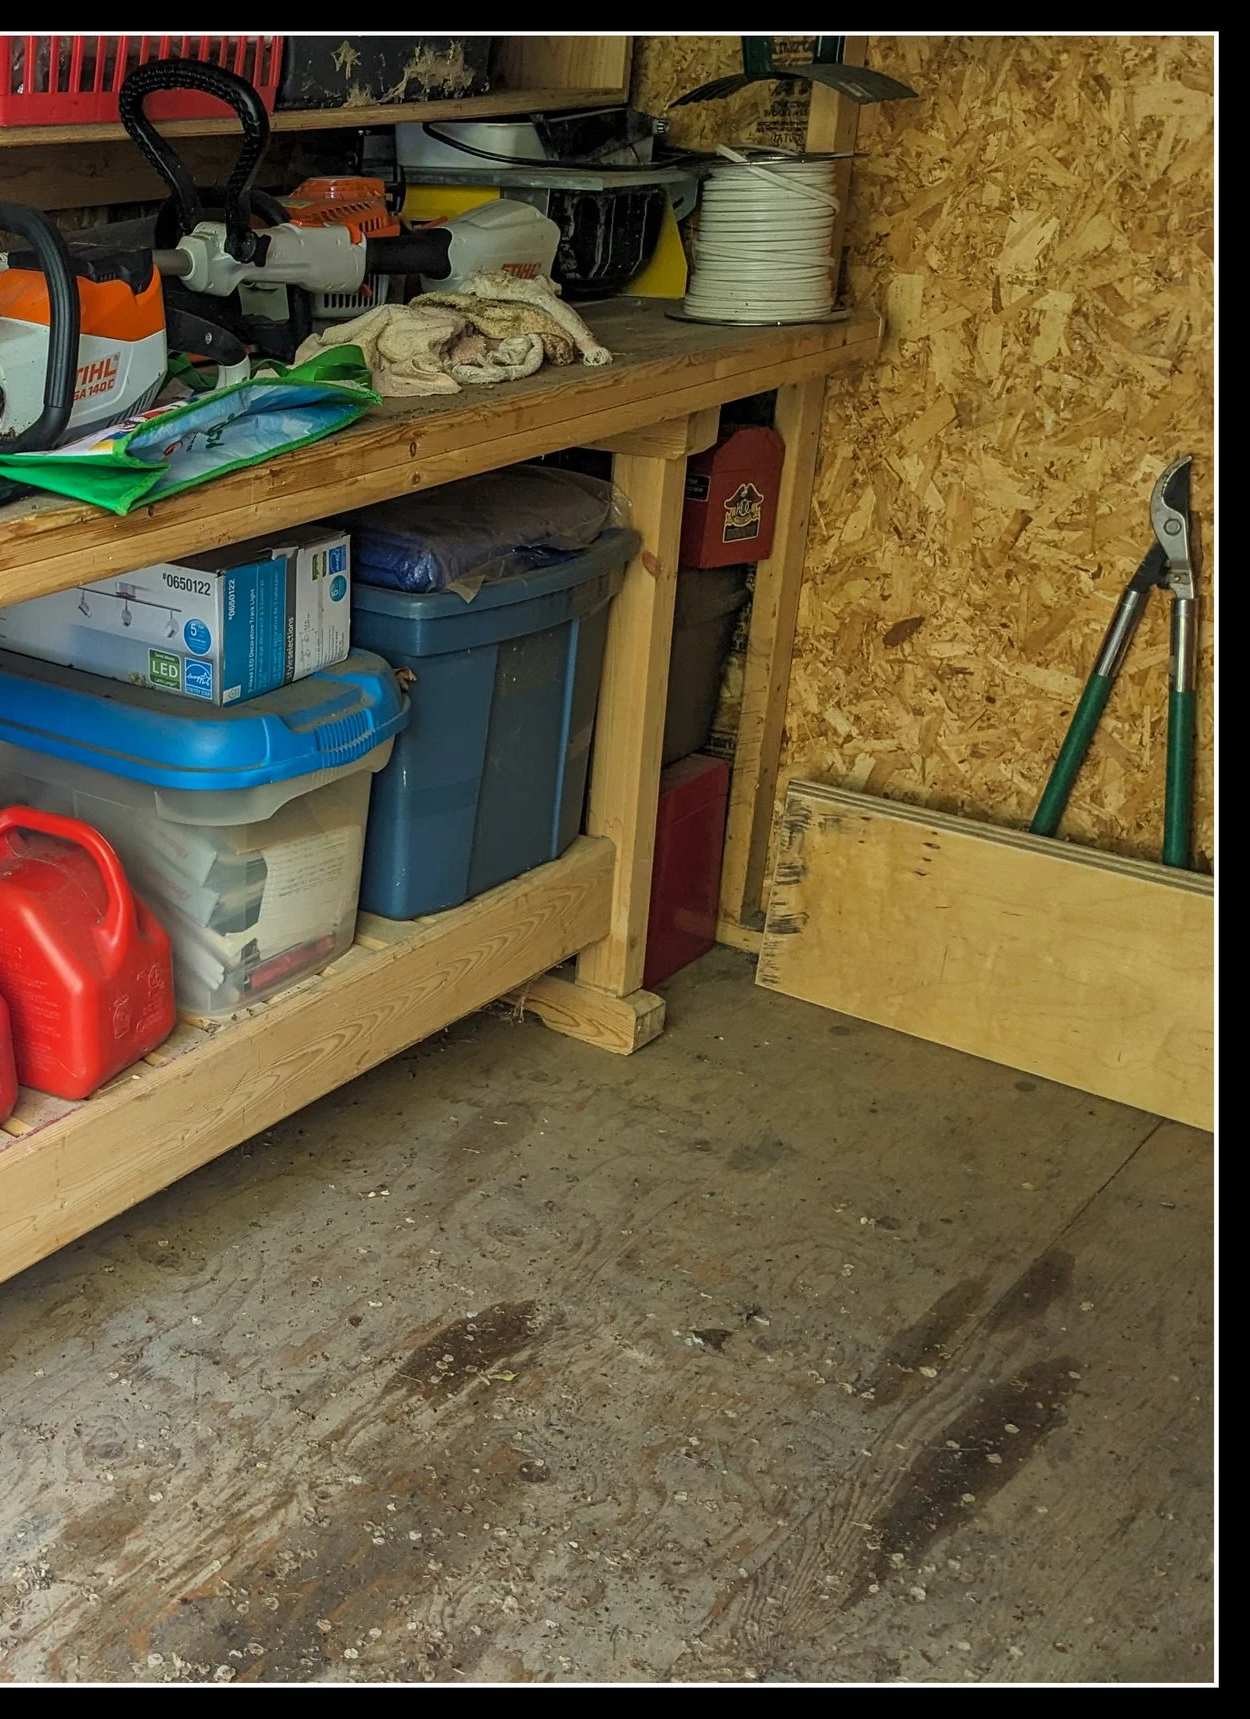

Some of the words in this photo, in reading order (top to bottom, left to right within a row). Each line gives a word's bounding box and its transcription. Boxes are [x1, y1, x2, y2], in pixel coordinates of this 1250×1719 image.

[76, 358, 117, 385] IHL
[162, 572, 211, 596] #0650122
[228, 578, 236, 620] #0650122
[190, 623, 198, 637] 5
[152, 660, 179, 678] LED
